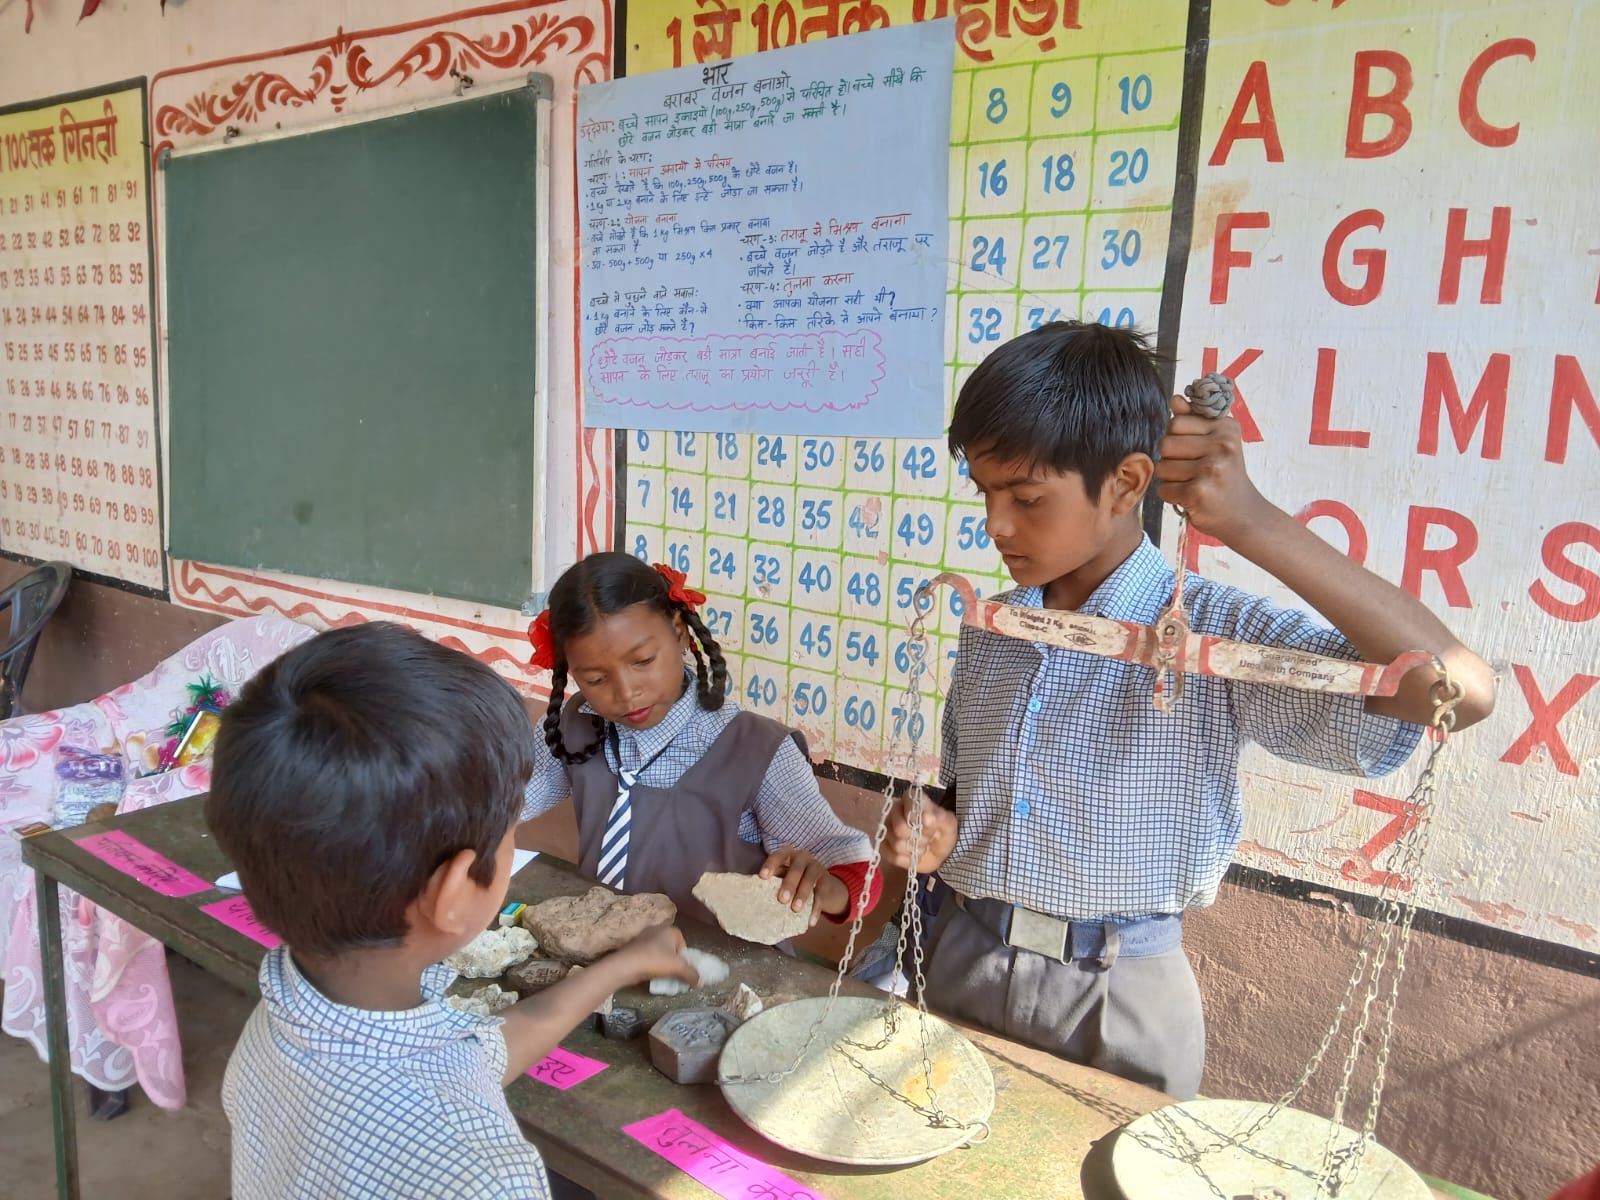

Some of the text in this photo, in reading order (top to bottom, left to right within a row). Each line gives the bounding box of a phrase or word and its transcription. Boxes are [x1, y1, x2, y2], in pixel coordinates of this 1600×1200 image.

[666, 17, 682, 68] 1
[663, 88, 705, 109] बराबर
[702, 62, 733, 86] भार
[986, 73, 1153, 124] 8 9 10
[1208, 37, 1537, 166] A B C
[59, 98, 118, 165] गिनती
[90, 185, 98, 204] 71
[108, 184, 117, 203] 81
[126, 180, 137, 199] 91
[978, 148, 1149, 197] 16 18 20
[74, 221, 141, 244] 62 72 82 92
[971, 228, 1141, 275] 24 27 30
[1209, 206, 1512, 306] F G H
[92, 262, 143, 285] 73 83 93
[112, 304, 146, 326] 84 94
[968, 307, 1002, 344] 32
[114, 343, 146, 368] 85 95
[117, 384, 149, 407] 86 96
[1201, 347, 1600, 465] K L M N
[101, 422, 111, 441] 77
[637, 430, 649, 452] 6
[674, 430, 695, 457] 12
[716, 431, 738, 461] 18
[758, 436, 786, 468] 24
[803, 440, 834, 471] 30
[855, 441, 884, 472] 36
[903, 446, 936, 479] 42
[104, 461, 152, 488] 78 88 98
[106, 501, 154, 526] 79 89 99
[637, 480, 650, 507] 7
[672, 487, 693, 516] 14
[714, 492, 736, 521] 21
[758, 496, 784, 528] 28
[802, 500, 832, 530] 35
[898, 513, 934, 546] 49
[958, 516, 991, 550] 56
[108, 540, 158, 568] 80 90 100
[634, 534, 648, 563] 8
[669, 543, 690, 572] 16
[709, 548, 736, 579] 24
[754, 555, 780, 585] 32
[800, 562, 831, 593] 40
[848, 572, 880, 607] 48
[897, 577, 932, 610] 56
[1399, 504, 1479, 608] R
[1529, 521, 1600, 623] S
[707, 608, 732, 635] 27
[750, 613, 778, 644] 36
[800, 623, 832, 657] 45
[846, 631, 879, 666] 54
[747, 675, 776, 706] 40
[794, 683, 827, 716] 50
[845, 695, 875, 731] 60
[892, 706, 924, 742] 70
[1498, 662, 1600, 777] X
[1341, 787, 1432, 892] Z
